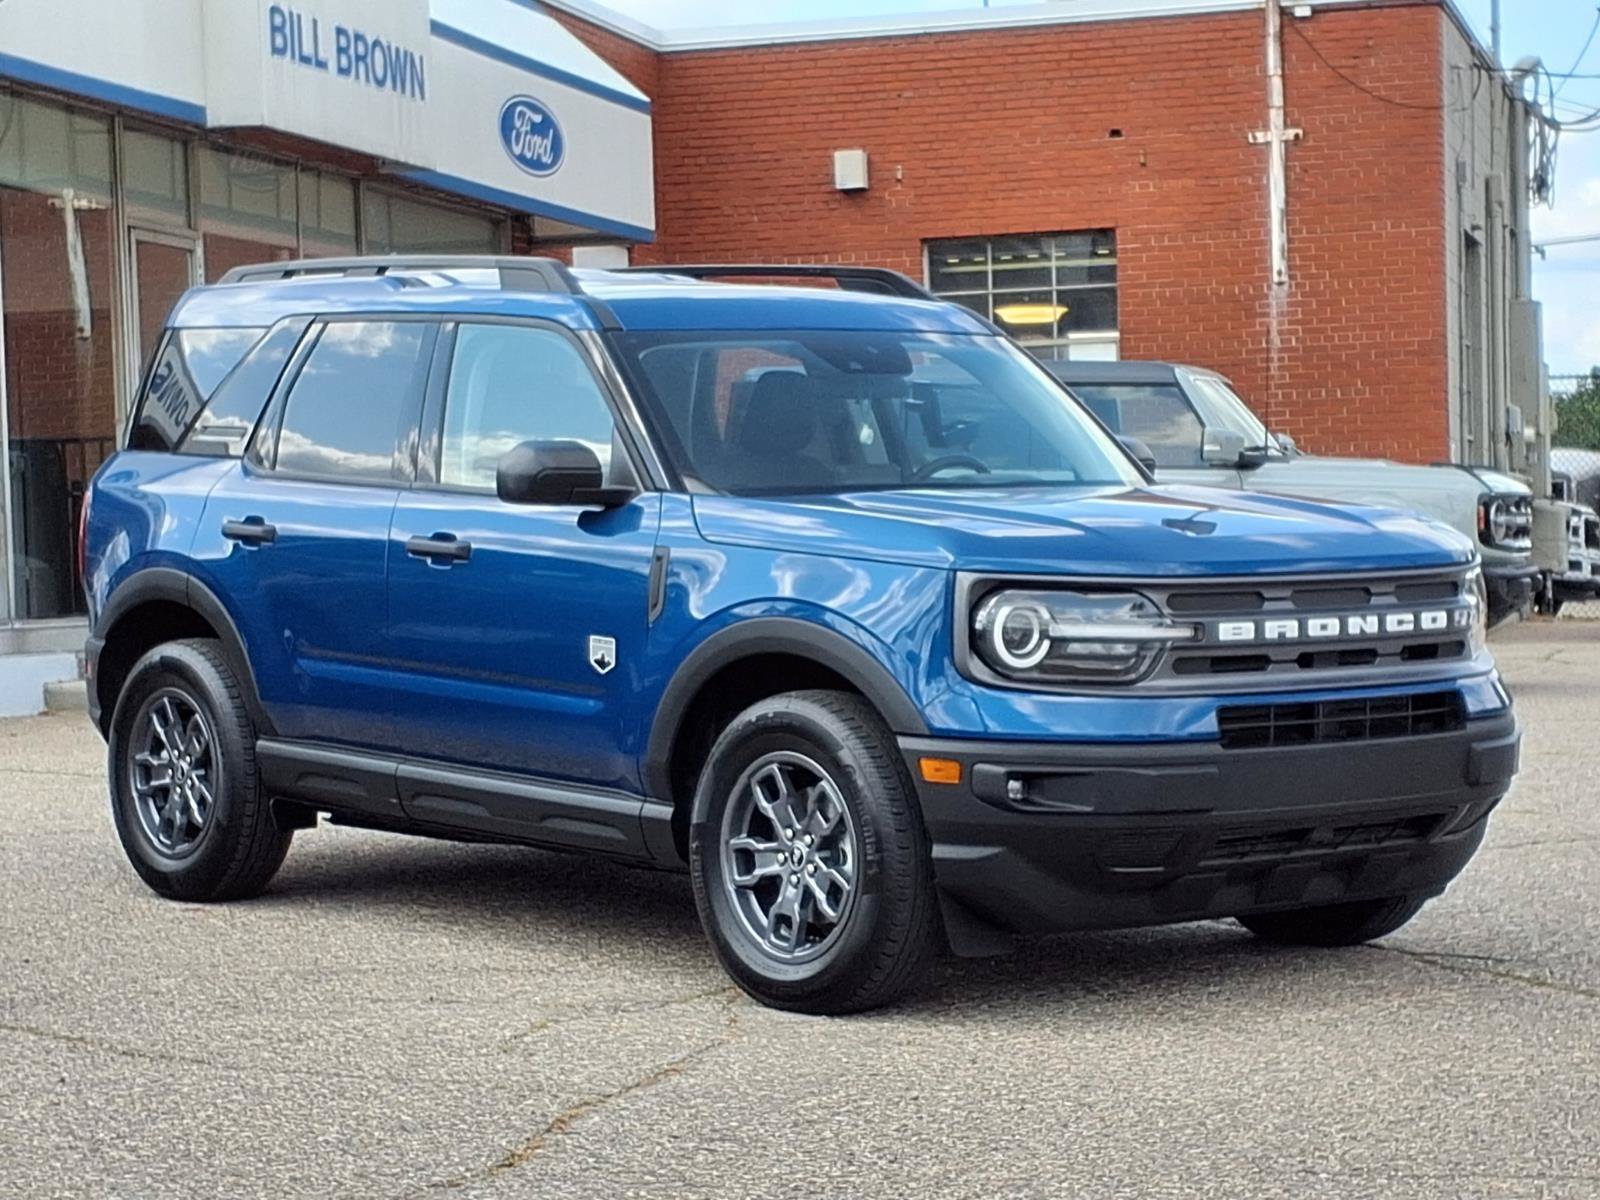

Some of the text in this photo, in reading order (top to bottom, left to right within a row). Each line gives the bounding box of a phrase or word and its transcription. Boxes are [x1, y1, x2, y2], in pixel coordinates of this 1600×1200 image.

[269, 5, 425, 101] BILL BROWN
[511, 105, 554, 164] Ford
[1218, 610, 1447, 641] BRONCO
